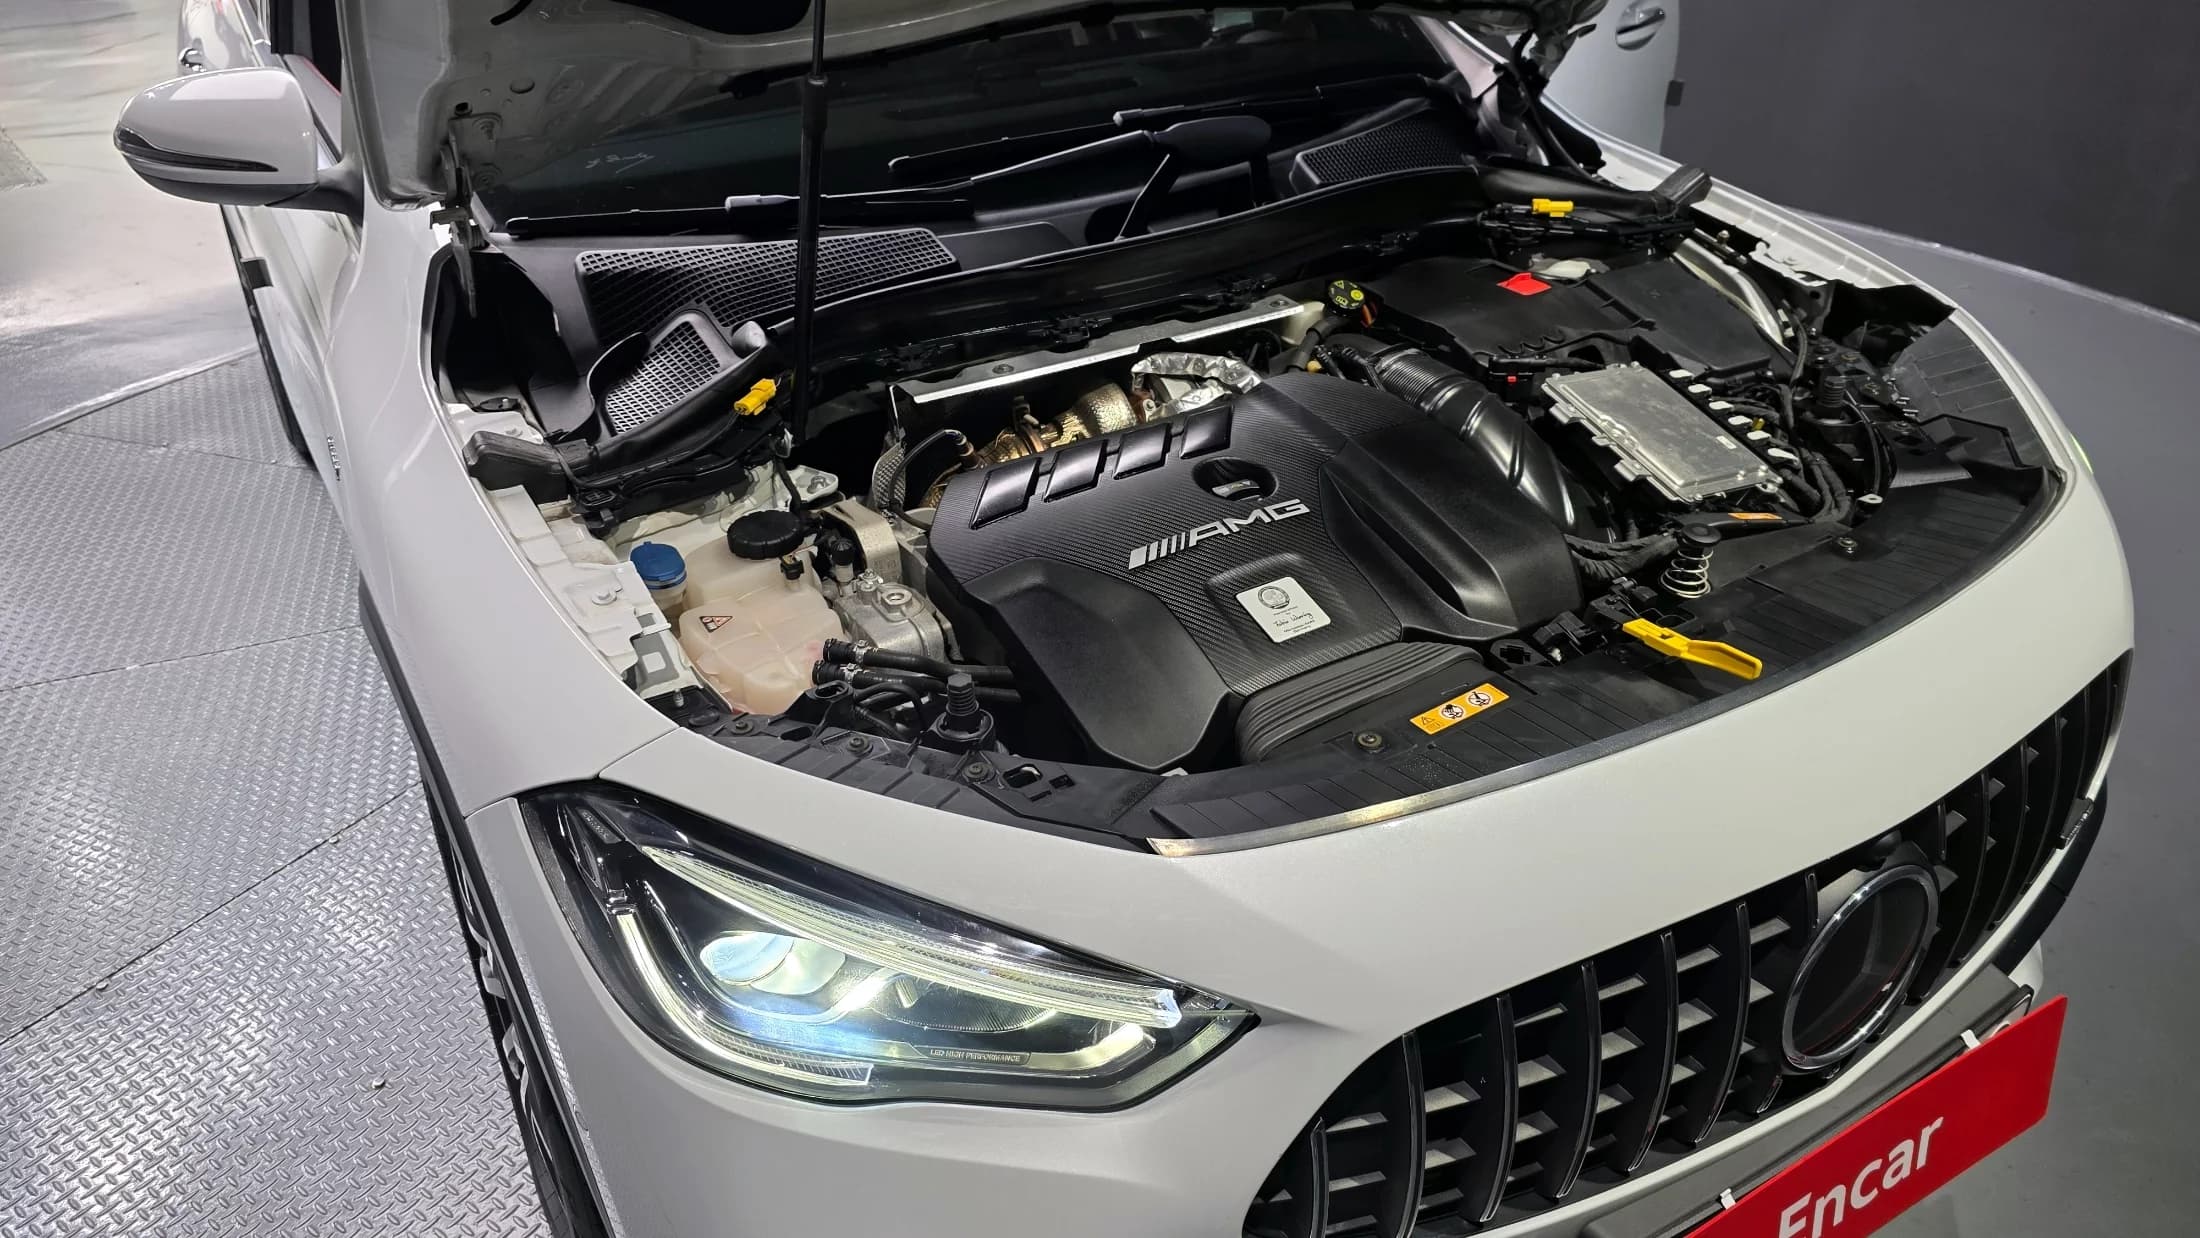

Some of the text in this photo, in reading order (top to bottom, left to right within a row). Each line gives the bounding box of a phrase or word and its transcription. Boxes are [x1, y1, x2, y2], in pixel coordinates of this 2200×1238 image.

[1189, 499, 1310, 547] AMG
[930, 1049, 1021, 1063] LED HIGH PERFORMANCE
[1778, 1116, 1944, 1238] Encar
